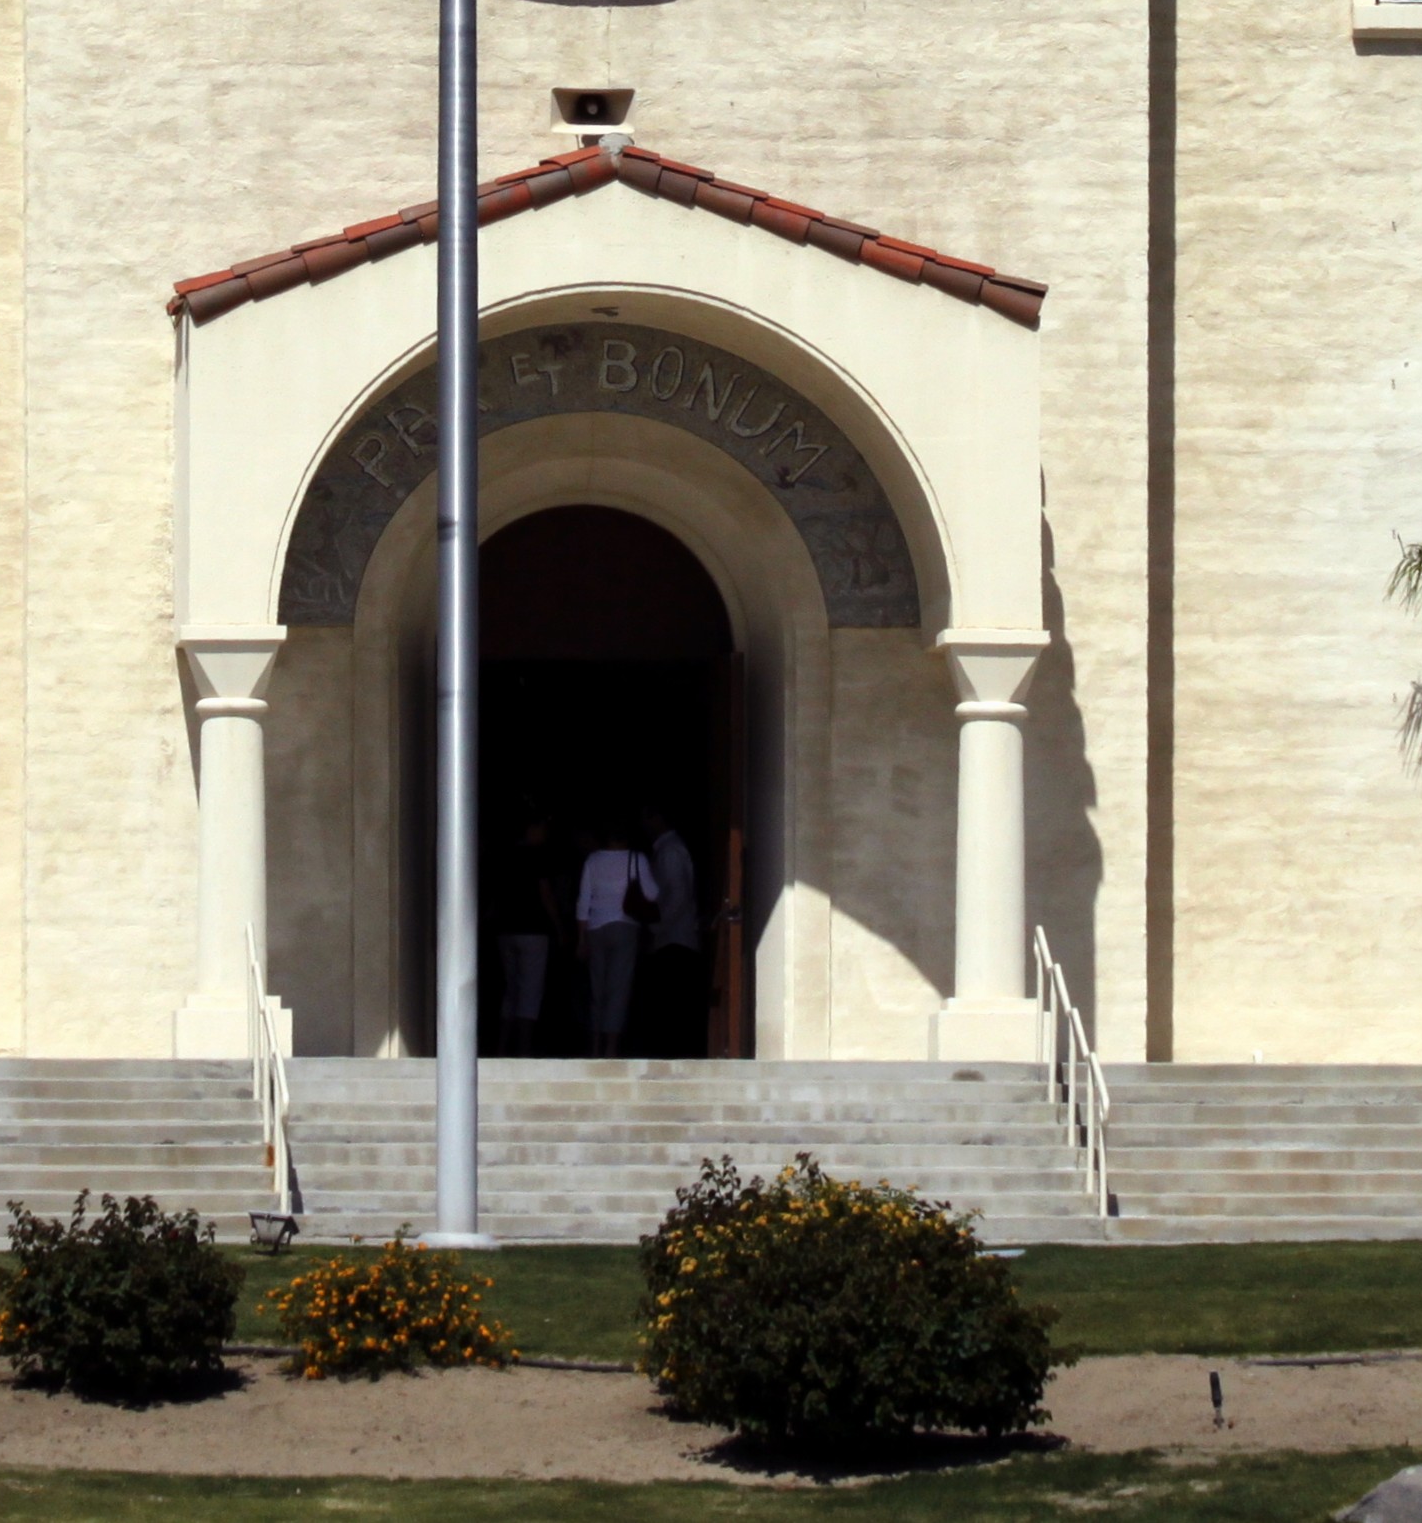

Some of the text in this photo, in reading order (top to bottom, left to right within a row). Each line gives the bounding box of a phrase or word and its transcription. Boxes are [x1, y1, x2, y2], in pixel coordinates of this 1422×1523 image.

[350, 339, 829, 488] PA ET BONUM
